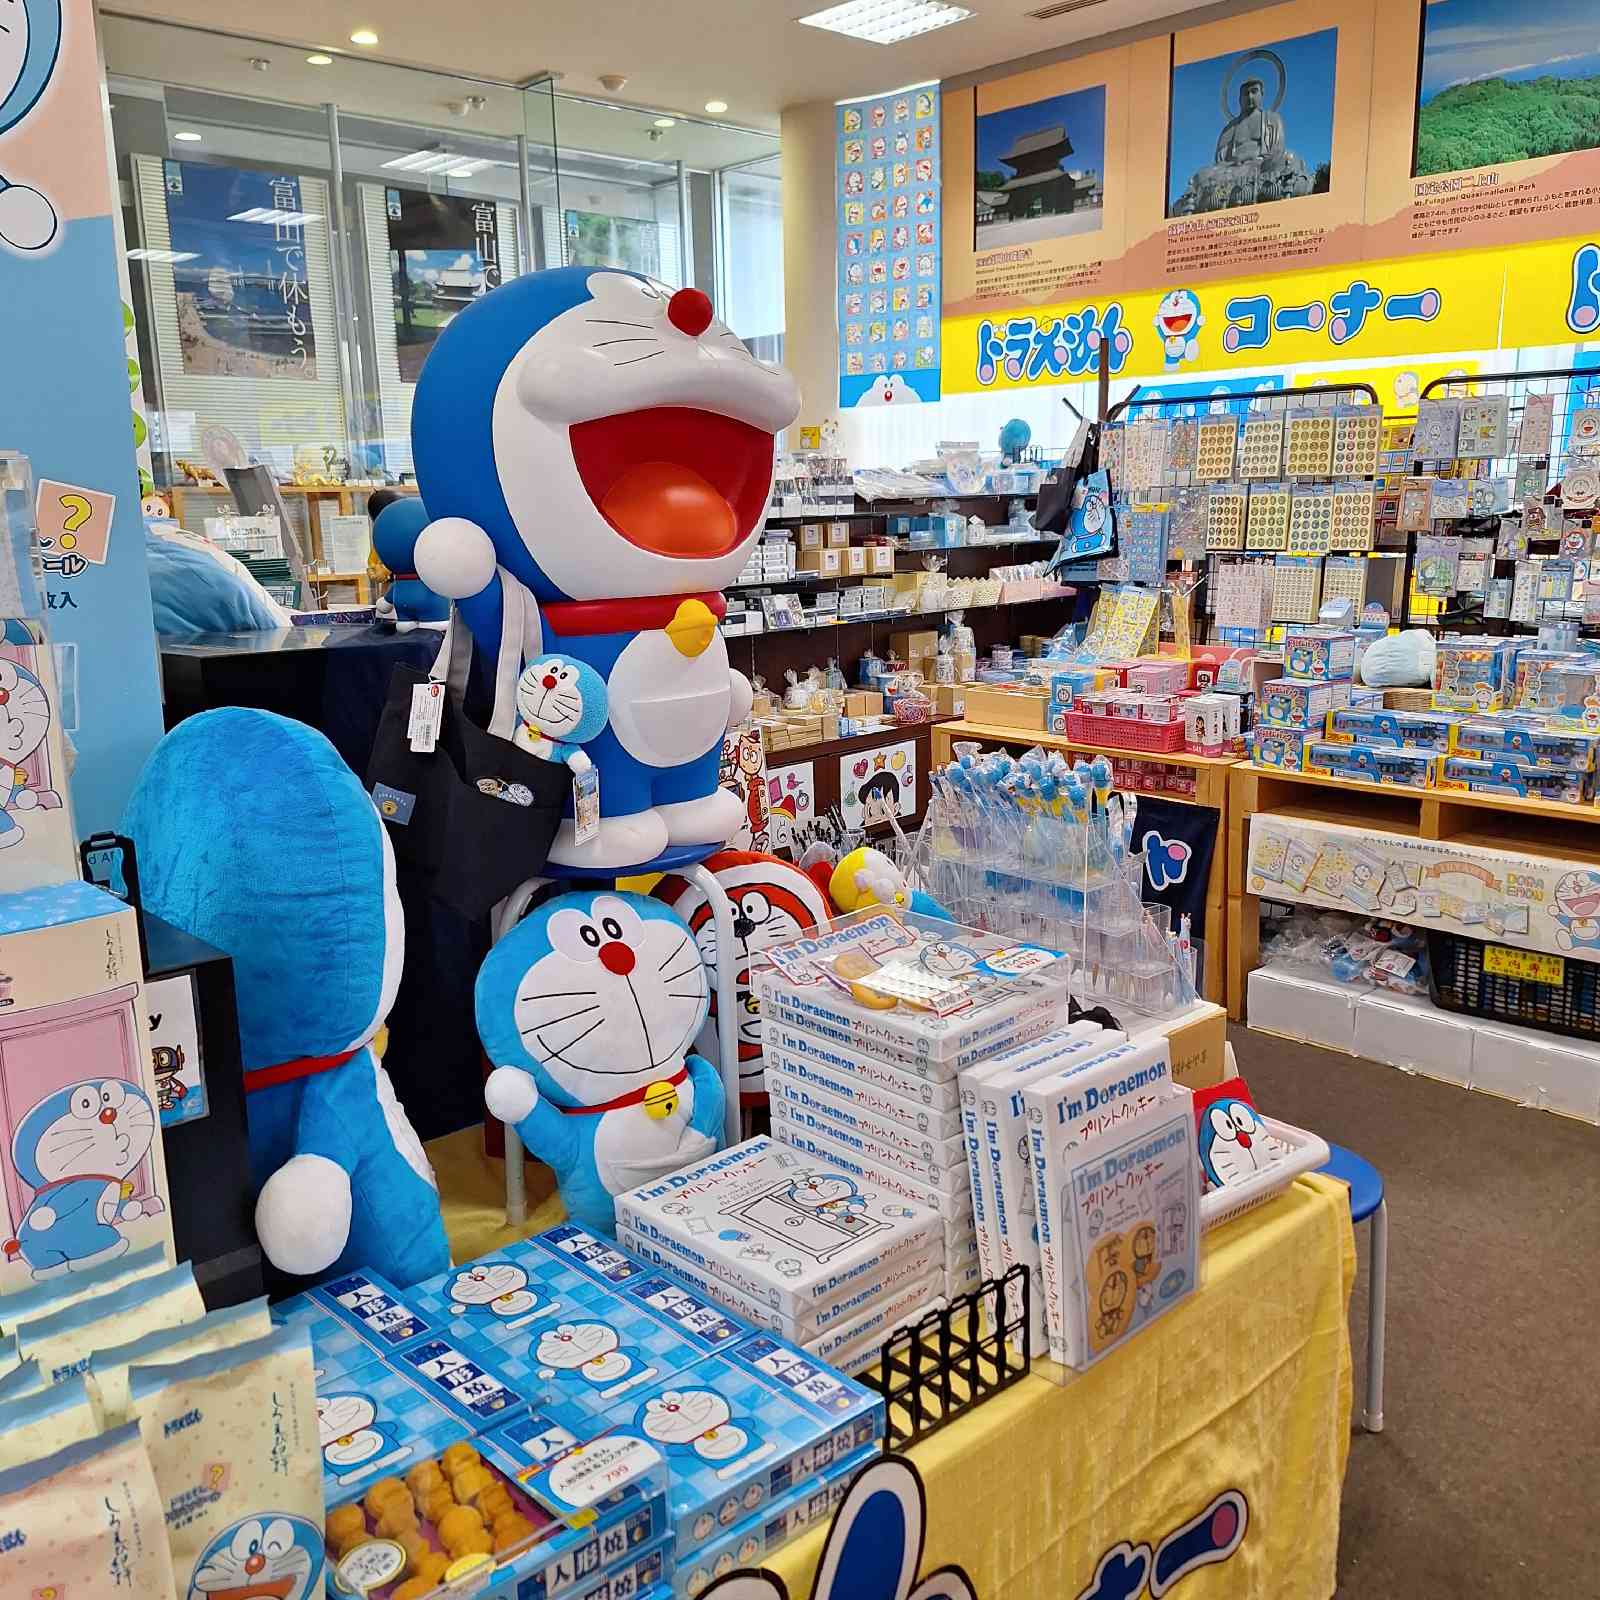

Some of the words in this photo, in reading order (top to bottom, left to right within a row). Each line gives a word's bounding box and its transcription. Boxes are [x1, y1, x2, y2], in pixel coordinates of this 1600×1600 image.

[1519, 183, 1536, 192] Park
[1223, 280, 1441, 353] コーナー
[800, 915, 890, 954] Doraemon
[773, 988, 790, 1005] I'm
[791, 993, 850, 1029] Doraemon
[779, 1007, 795, 1023] I'm
[796, 1012, 852, 1044] Doraemon
[973, 1015, 1015, 1042] Doraemon
[781, 1030, 797, 1047] I'm
[797, 1036, 856, 1072] Doraemon
[971, 1036, 1014, 1060] Doraemon
[781, 1056, 797, 1073] I'm
[799, 1064, 854, 1099] Doraemon
[1057, 1097, 1083, 1125] I'm
[1085, 1060, 1167, 1112] Doraemon
[784, 1084, 799, 1100] I'm
[800, 1091, 857, 1126] Doraemon
[1080, 1095, 1156, 1140] プリントクッキー
[790, 1107, 806, 1123] I'm
[807, 1112, 864, 1150] Doraemon
[986, 1120, 998, 1145] I'm
[1031, 1128, 1043, 1152] I'm
[634, 1187, 667, 1202] I'm
[665, 1140, 769, 1189] Doraemon
[790, 1133, 806, 1150] I'm
[807, 1140, 864, 1176] Doraemon
[1104, 1128, 1186, 1177] Doraemon
[968, 1134, 985, 1224] Doraemon
[988, 1146, 1009, 1236] Doraemon
[1034, 1153, 1051, 1243] Doraemon
[634, 1216, 650, 1232] I'm
[650, 1226, 705, 1265] Doraemon
[637, 1241, 652, 1257] I'm
[653, 1250, 708, 1290] Doraemon
[829, 1258, 880, 1288] Doraemon
[832, 1282, 882, 1317] Doraemon
[834, 1311, 884, 1350] Doraemon
